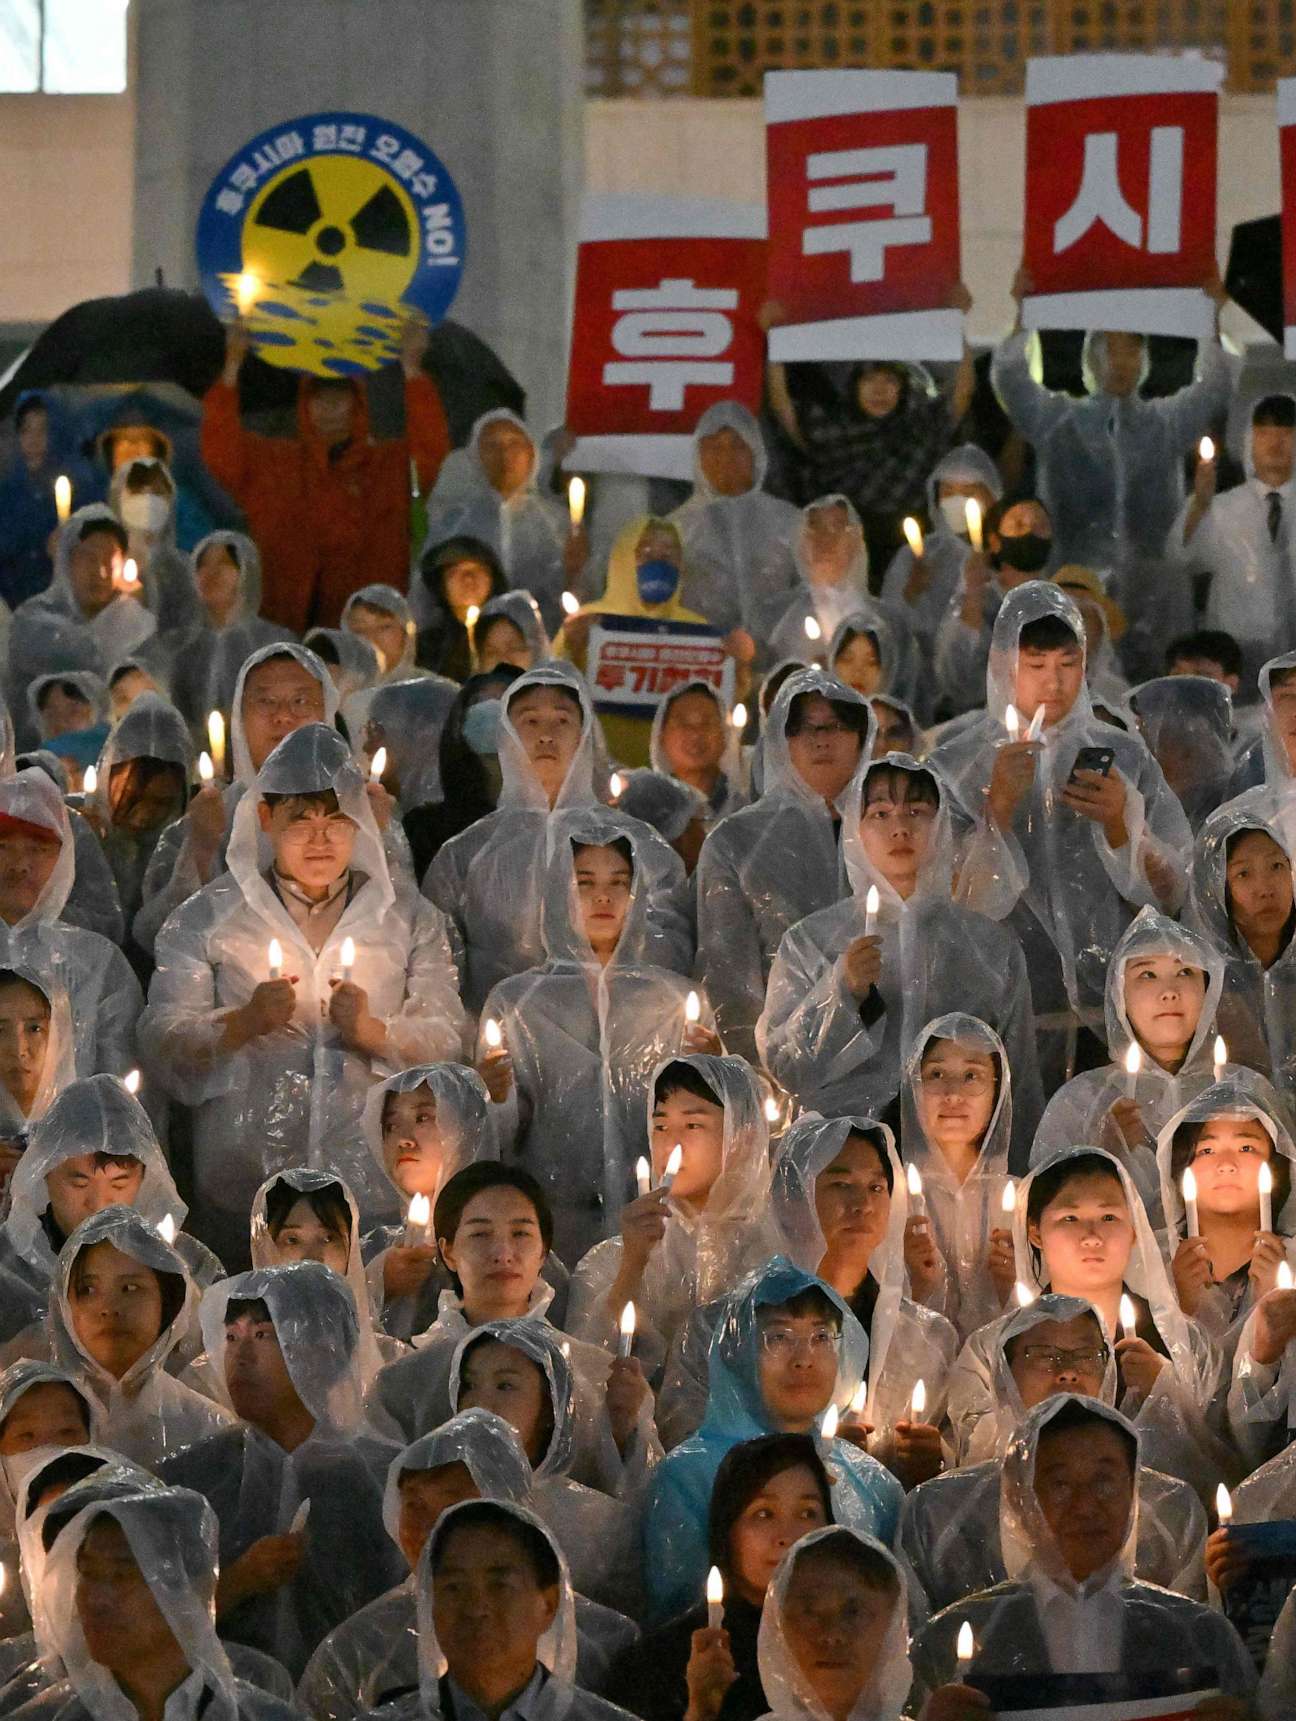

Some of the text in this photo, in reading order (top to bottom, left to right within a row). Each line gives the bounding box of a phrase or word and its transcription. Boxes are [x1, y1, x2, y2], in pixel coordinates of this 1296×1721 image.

[423, 203, 460, 266] NO!
[803, 143, 932, 283] 쿠
[1054, 126, 1183, 254] 시
[603, 279, 738, 411] 후
